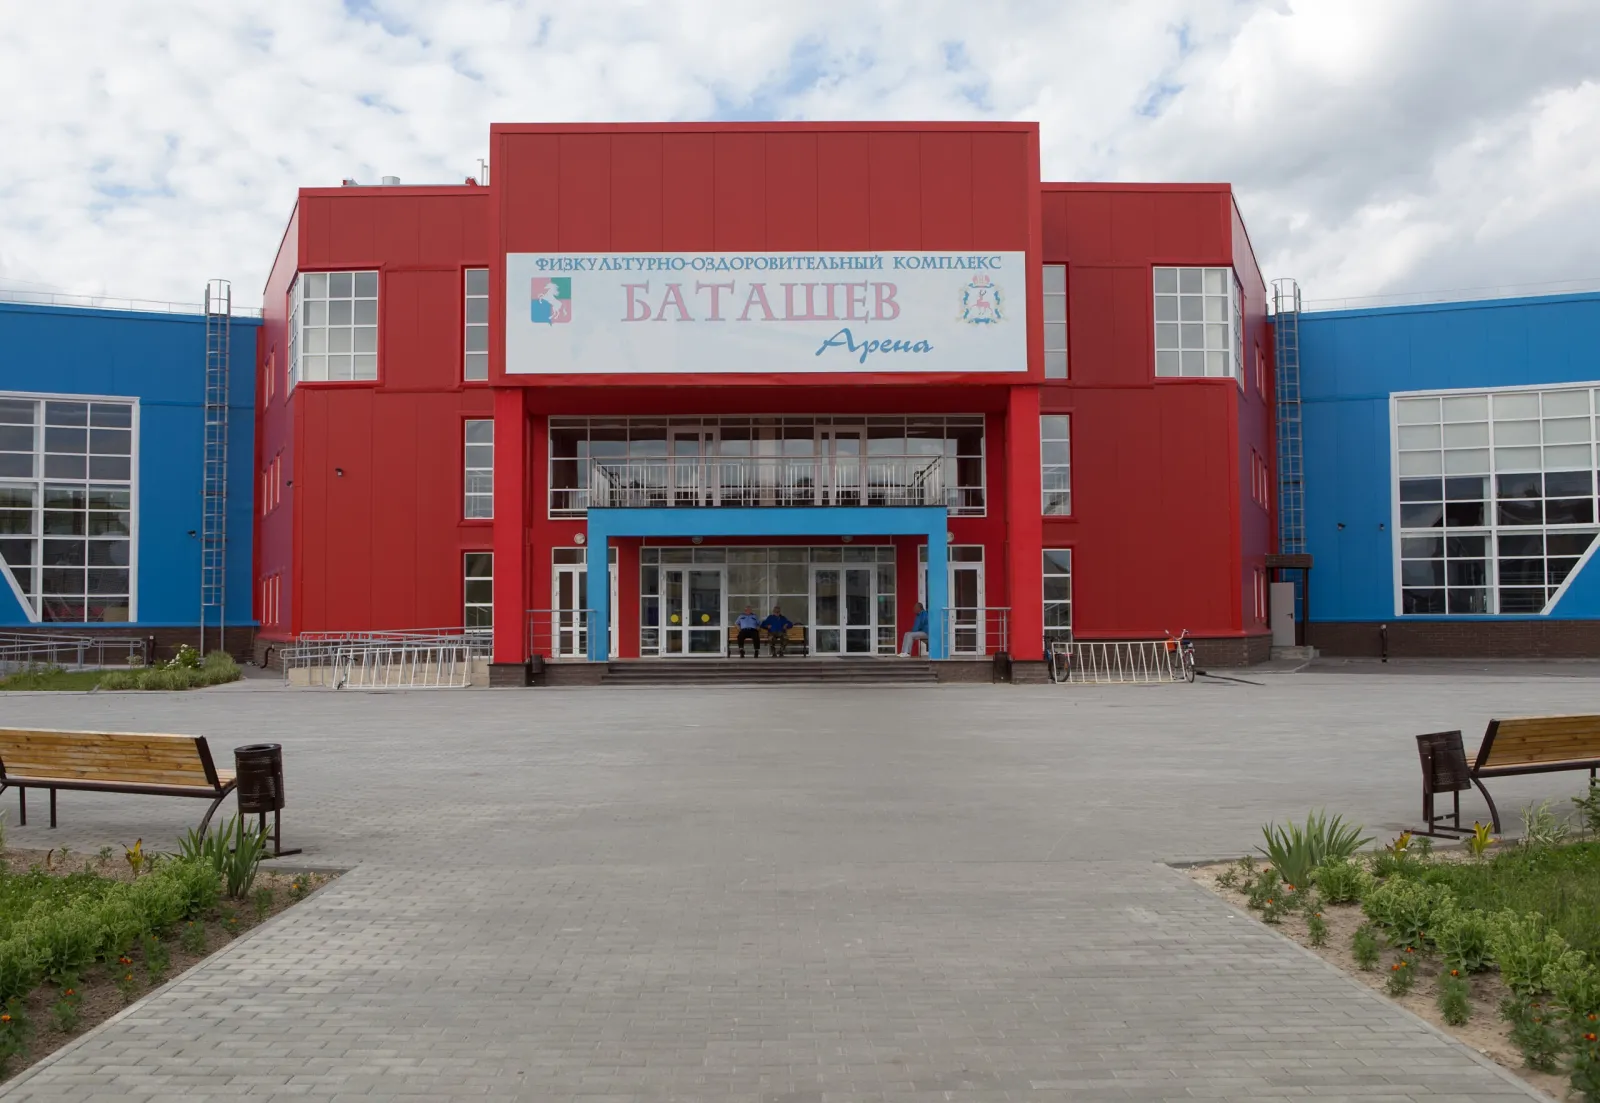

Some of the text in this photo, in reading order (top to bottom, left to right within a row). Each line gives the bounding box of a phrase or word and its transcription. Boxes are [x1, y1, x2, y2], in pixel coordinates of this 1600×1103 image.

[535, 255, 1001, 272] ФИЗКУЛЬТУРНО-ОЗДОРОВИТЕЛЬНЫЙ КОМПЛЕКС
[620, 279, 901, 323] БАТАШЕВ
[815, 328, 934, 364] Арена
